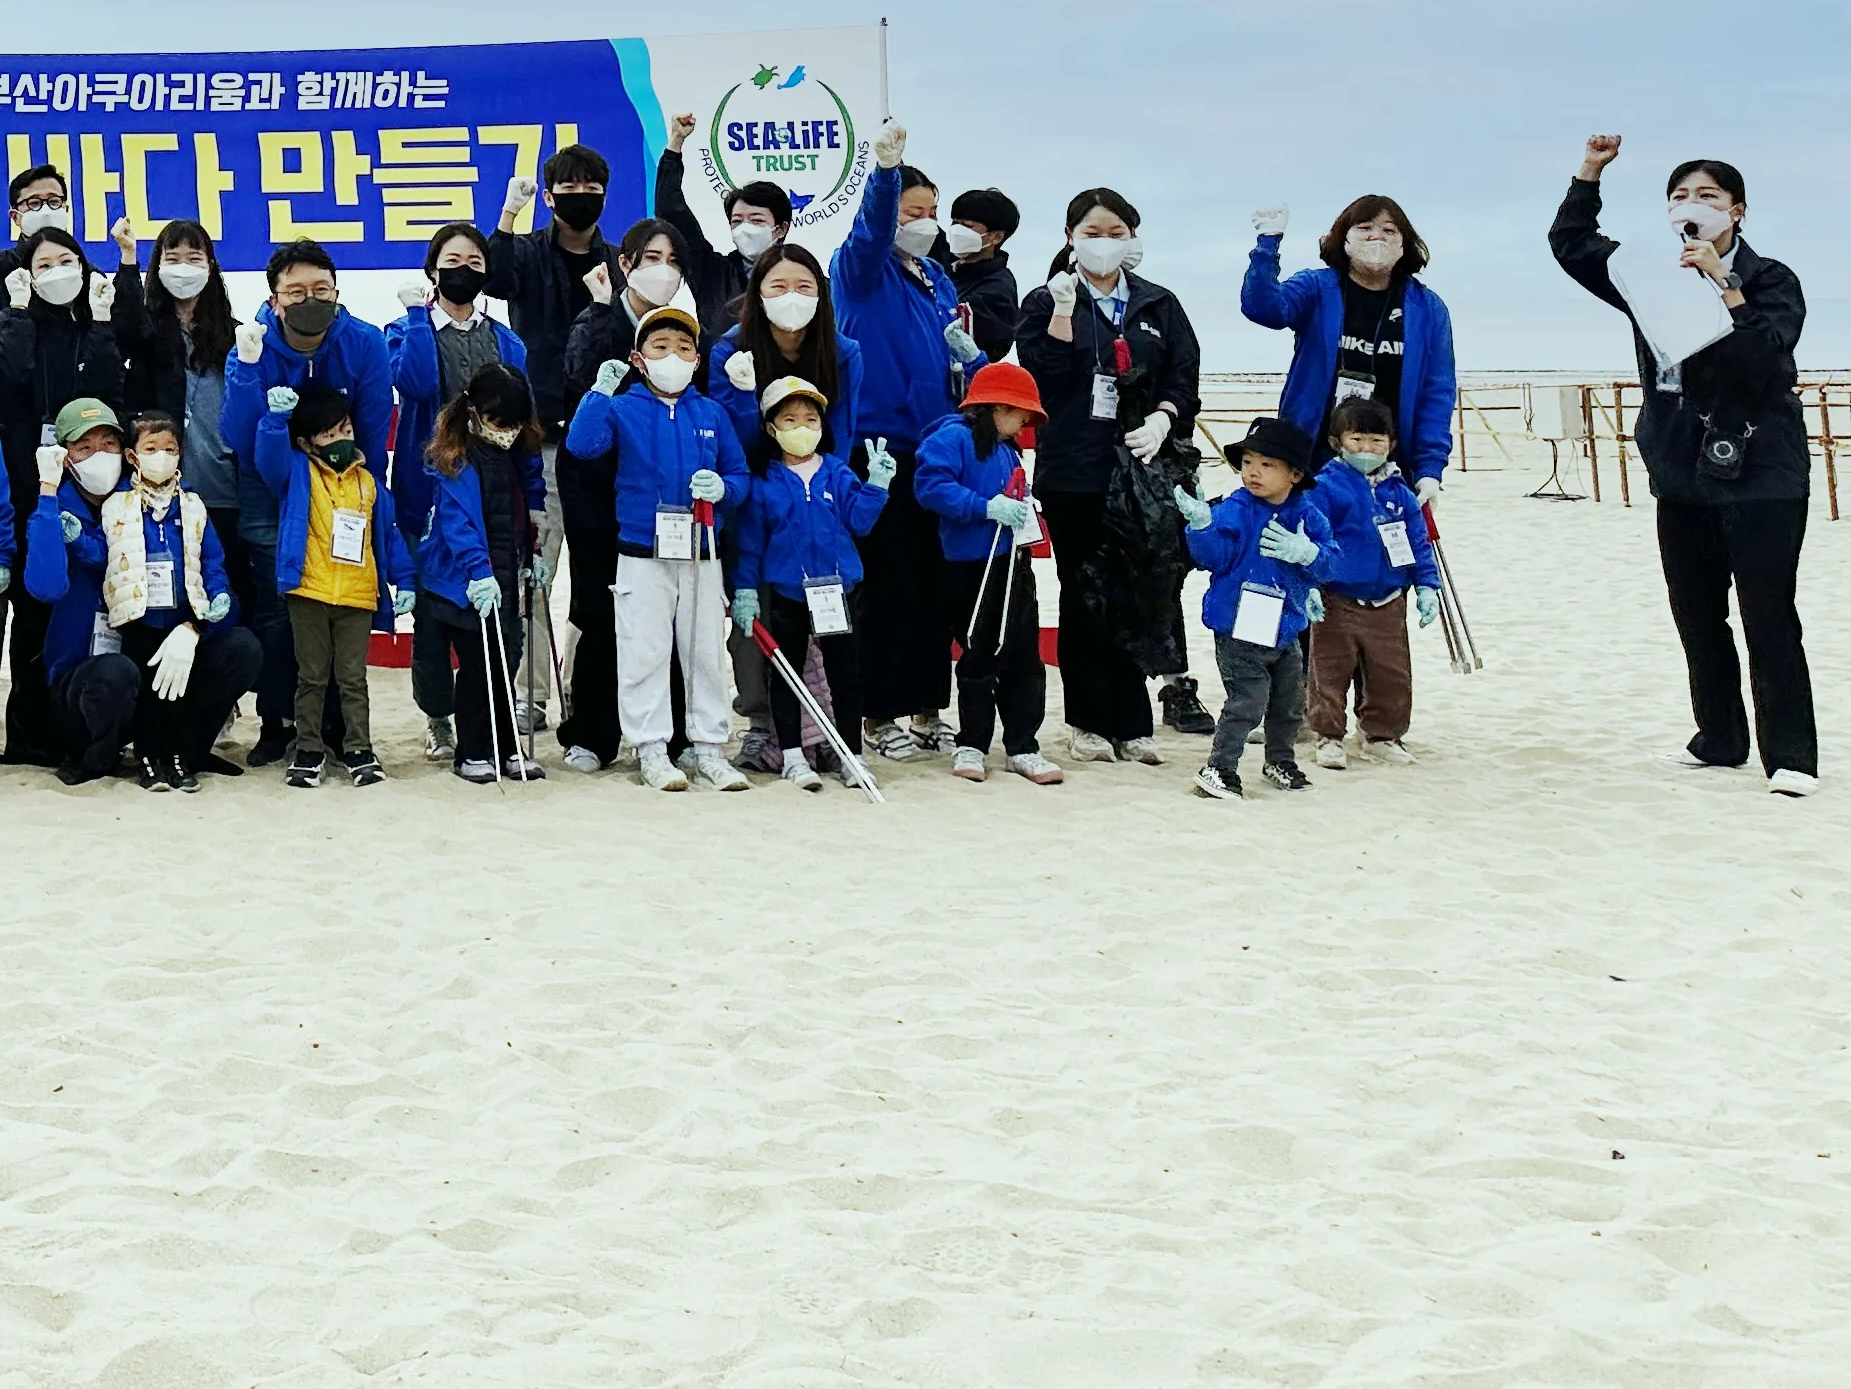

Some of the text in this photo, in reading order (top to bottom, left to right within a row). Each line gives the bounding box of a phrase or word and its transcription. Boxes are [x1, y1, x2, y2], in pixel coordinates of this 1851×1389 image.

[297, 70, 450, 109] 함께하는
[6, 133, 235, 242] 바다
[699, 147, 731, 201] PROTEC
[844, 140, 870, 197] OCEANS
[752, 154, 819, 172] TRUST
